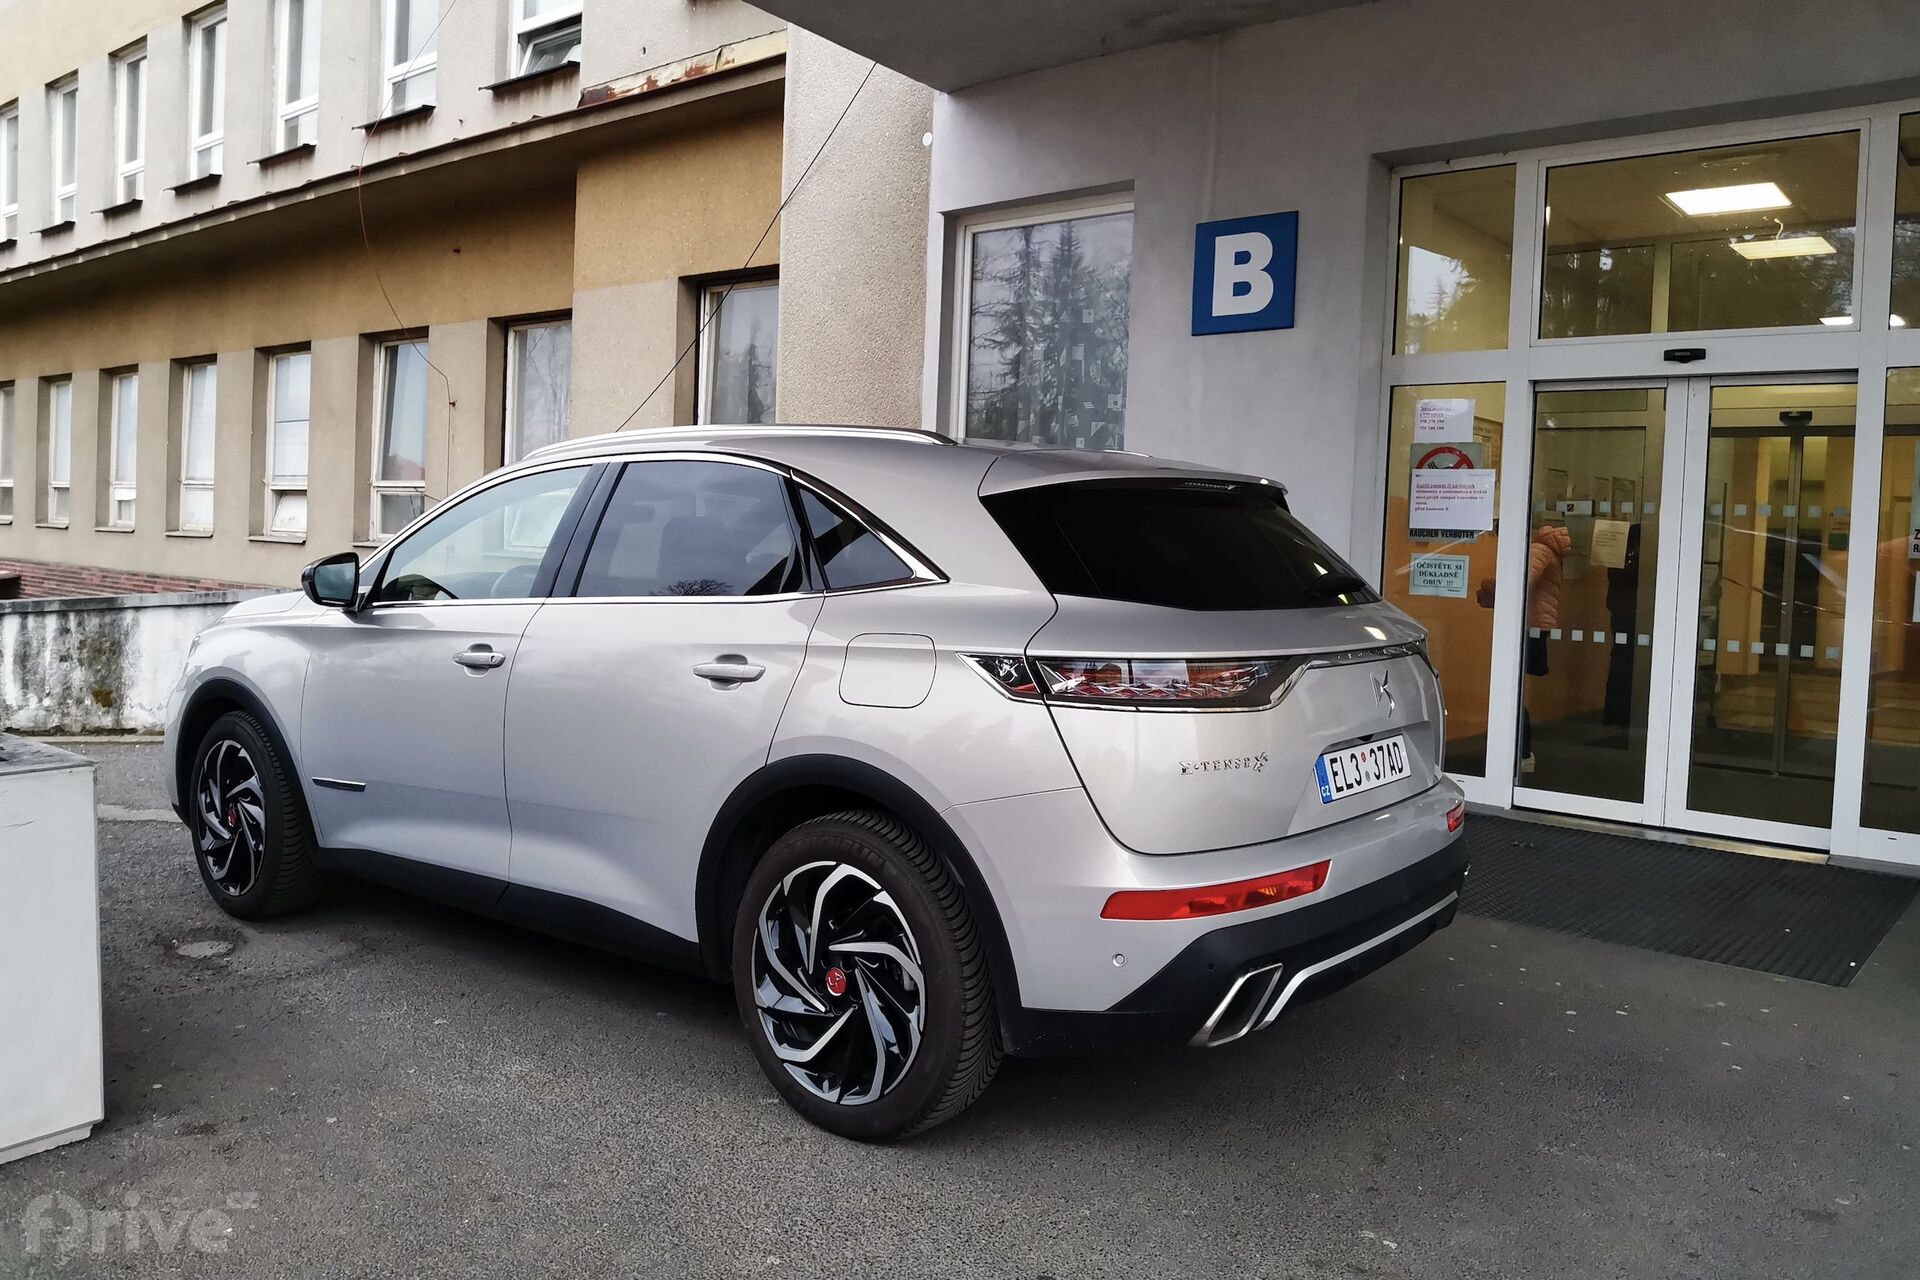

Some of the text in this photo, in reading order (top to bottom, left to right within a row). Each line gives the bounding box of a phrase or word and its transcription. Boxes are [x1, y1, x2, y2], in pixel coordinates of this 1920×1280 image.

[1212, 231, 1274, 317] B
[1409, 529, 1475, 539] RAUCHEN VERBOTEN
[1422, 578, 1443, 586] OBUV
[1329, 741, 1404, 794] EL3 37AD
[1320, 784, 1331, 798] CZ
